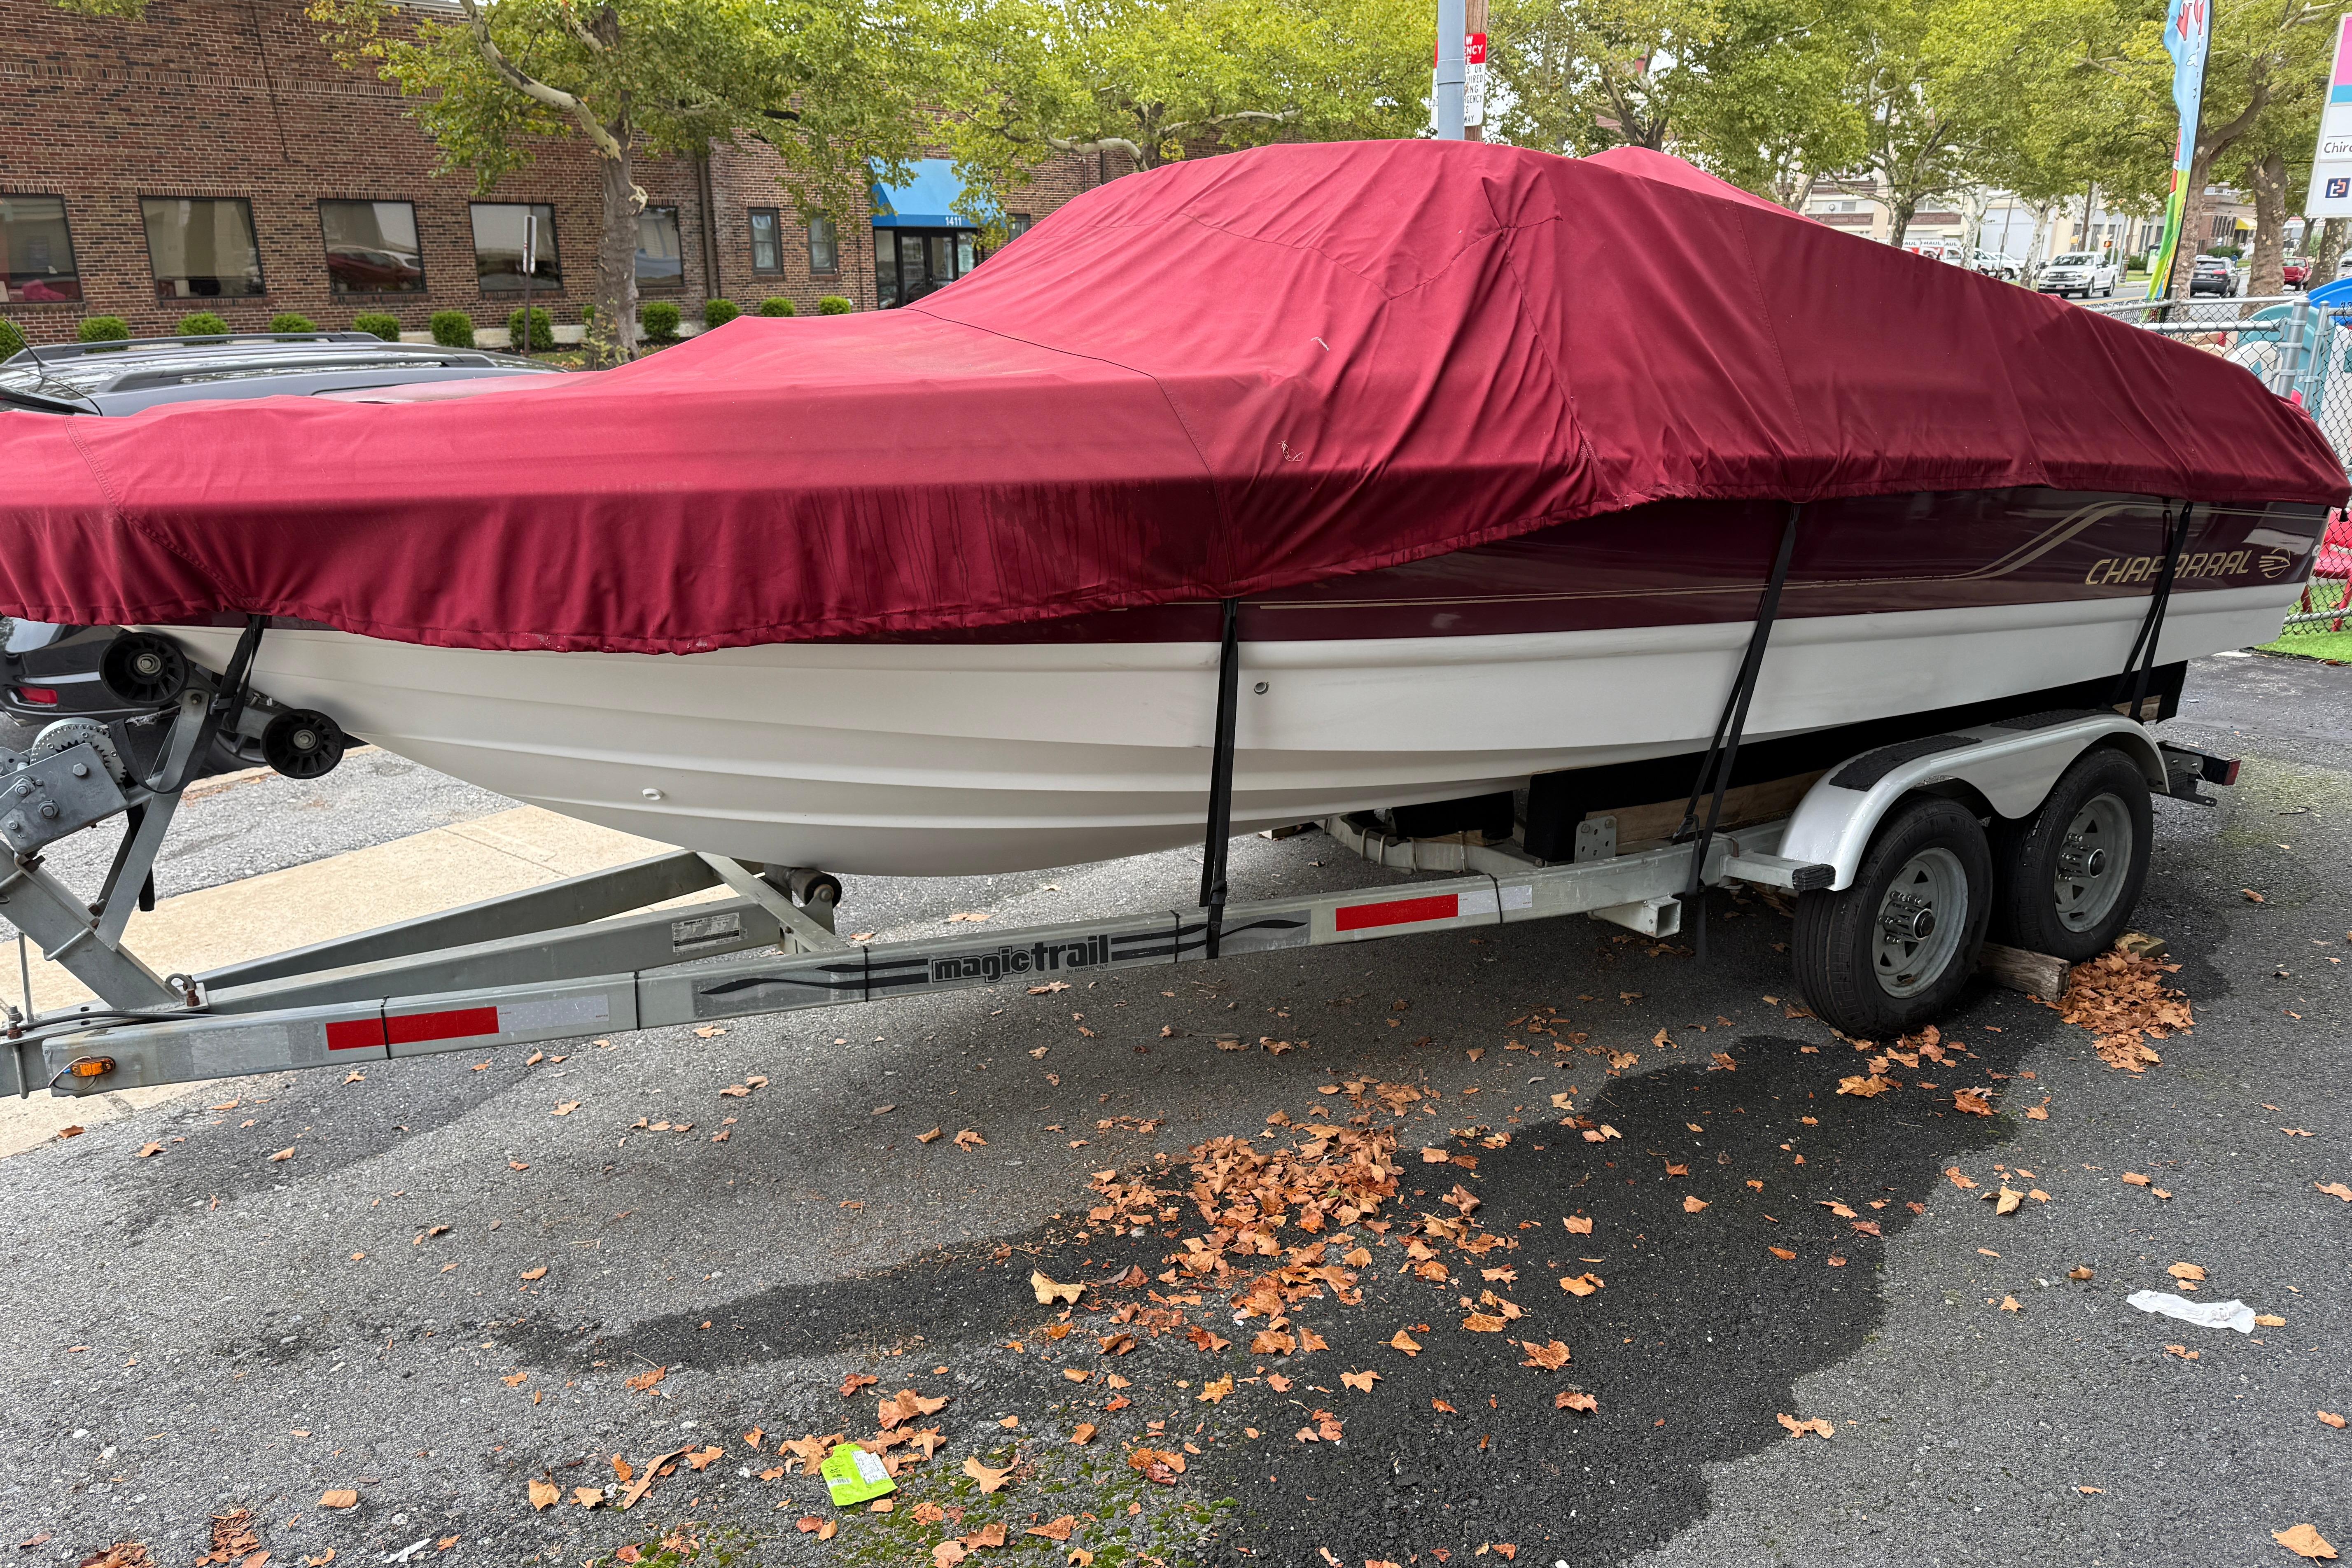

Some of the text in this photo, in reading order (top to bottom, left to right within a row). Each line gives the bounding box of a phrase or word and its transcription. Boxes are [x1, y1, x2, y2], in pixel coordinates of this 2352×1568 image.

[1475, 65, 1482, 73] OR
[945, 217, 961, 226] 1411
[2085, 550, 2252, 585] CHAPARRAL
